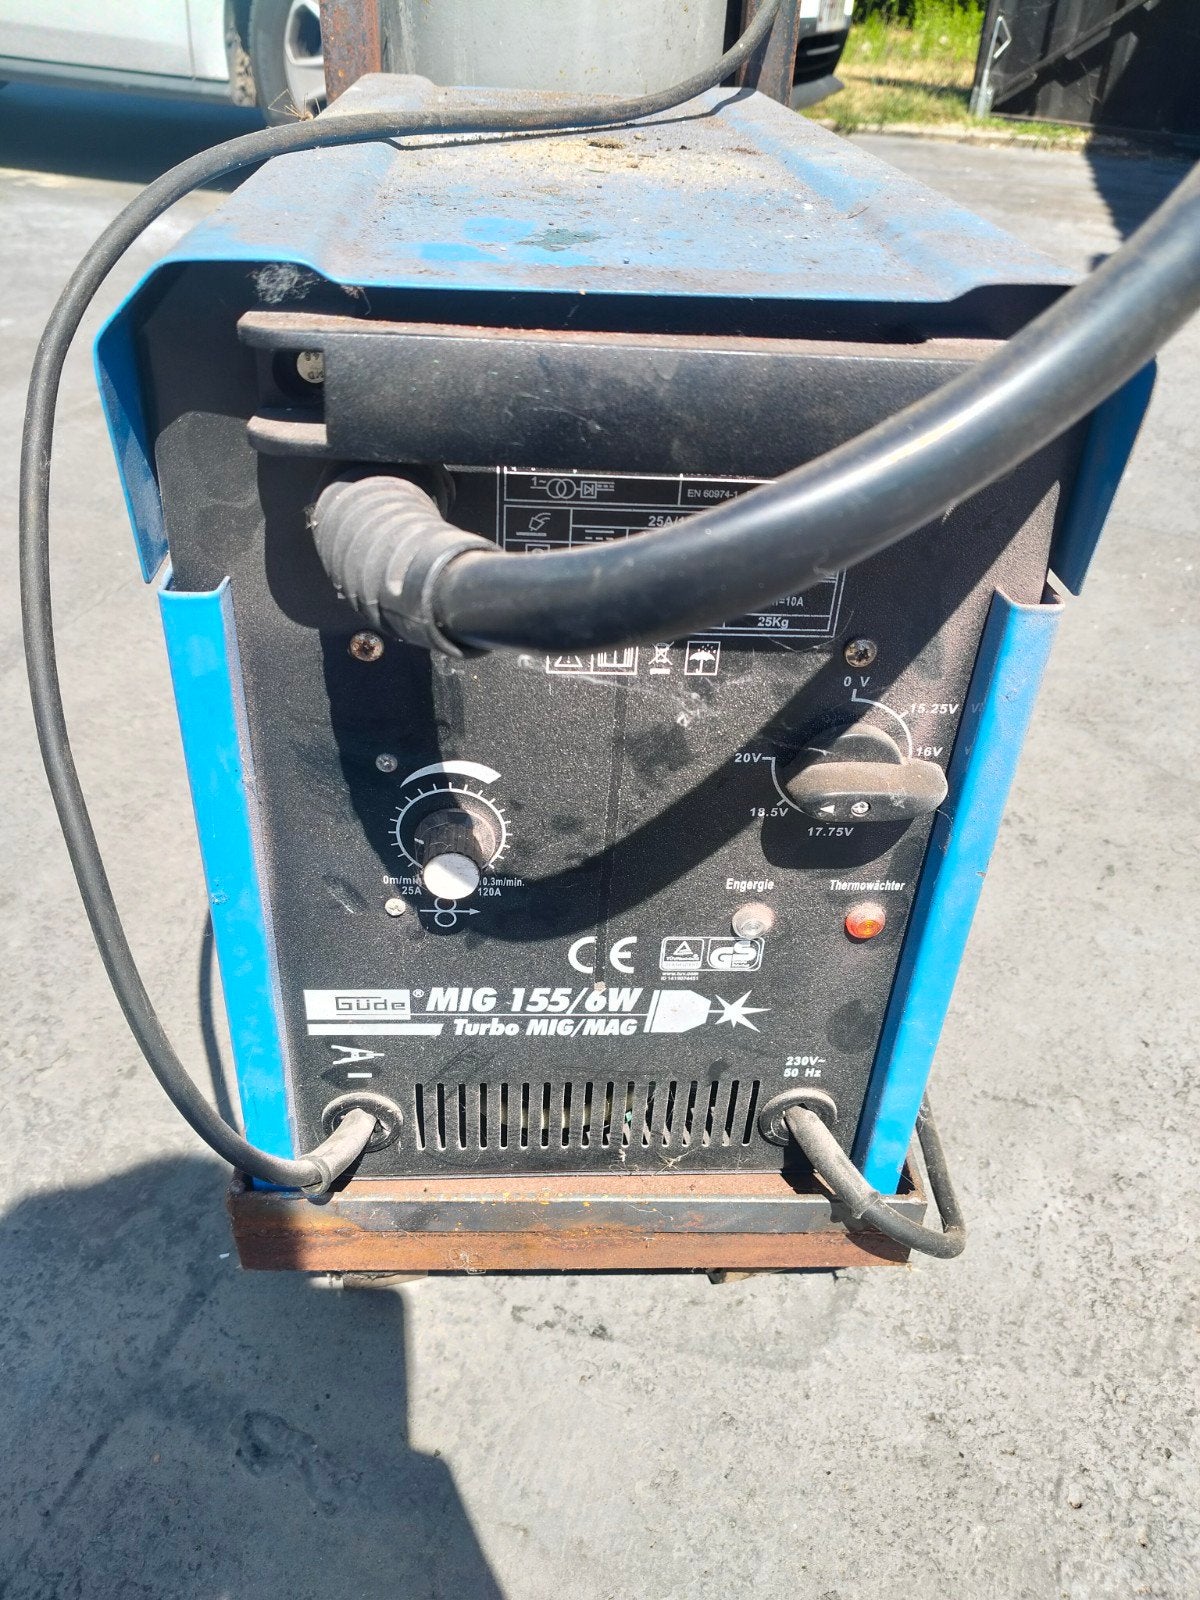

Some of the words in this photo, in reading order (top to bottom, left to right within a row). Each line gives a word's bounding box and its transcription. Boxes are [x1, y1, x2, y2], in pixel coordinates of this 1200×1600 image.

[687, 488, 701, 498] EN
[757, 616, 789, 629] 25Kg
[843, 676, 852, 687] 0
[860, 676, 870, 687] V
[910, 703, 959, 714] 15.25V
[916, 746, 943, 757] 16V
[735, 752, 762, 763] 20V
[750, 807, 789, 818] 18.5V
[807, 826, 854, 838] 17.75V
[402, 886, 422, 895] 25A
[726, 878, 774, 892] Engergie
[830, 879, 905, 892] Thermowächter
[478, 887, 502, 897] 120A
[335, 996, 406, 1011] Güde
[426, 987, 498, 1012] MIG
[511, 986, 643, 1014] 155/6W
[453, 1018, 520, 1036] Turbo
[525, 1018, 638, 1037] MIG/MAG
[784, 1067, 799, 1077] 50
[805, 1067, 821, 1077] Hz
